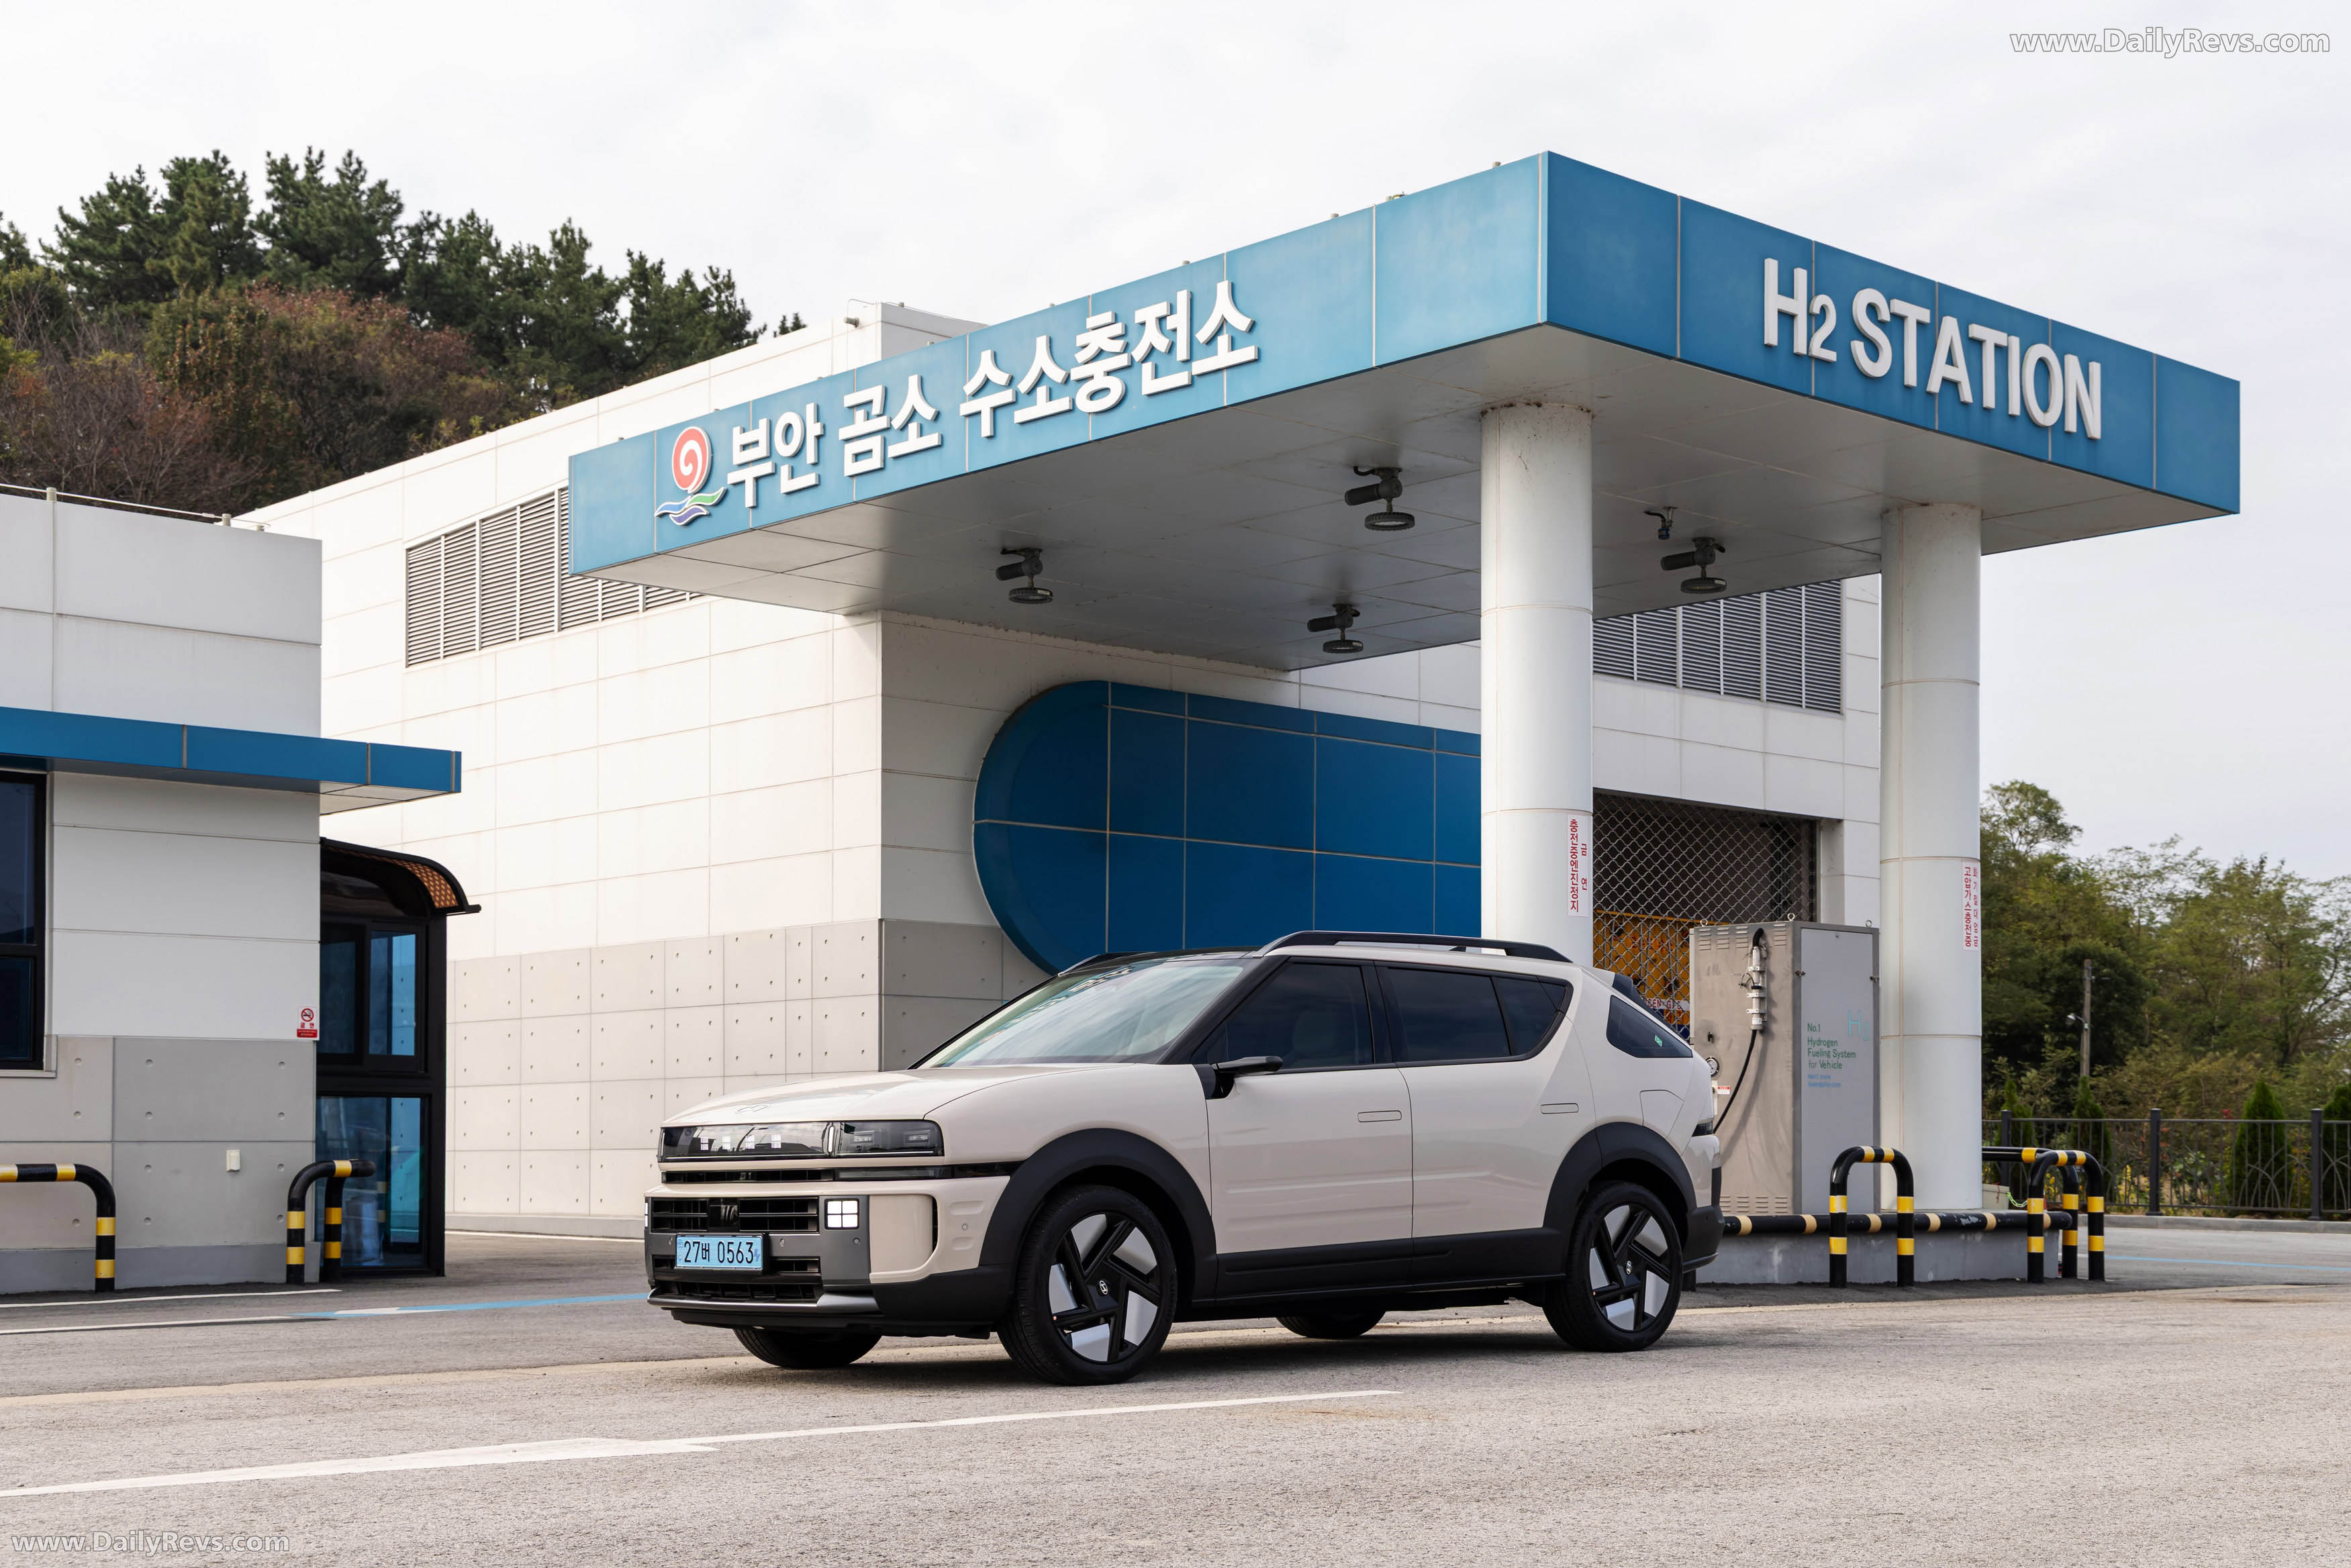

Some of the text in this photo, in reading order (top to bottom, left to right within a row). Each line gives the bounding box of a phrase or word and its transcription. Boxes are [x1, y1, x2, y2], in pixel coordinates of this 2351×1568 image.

[1764, 257, 2101, 440] H2 STATION
[727, 279, 1259, 509] 부안 곰소 수소충전소
[1807, 1022, 1821, 1032] No.1
[1807, 1036, 1838, 1048] Hydrogen
[1807, 1048, 1856, 1059] Fueling System
[1809, 1061, 1843, 1069] for Vehicle
[684, 1240, 754, 1264] 27버 0563
